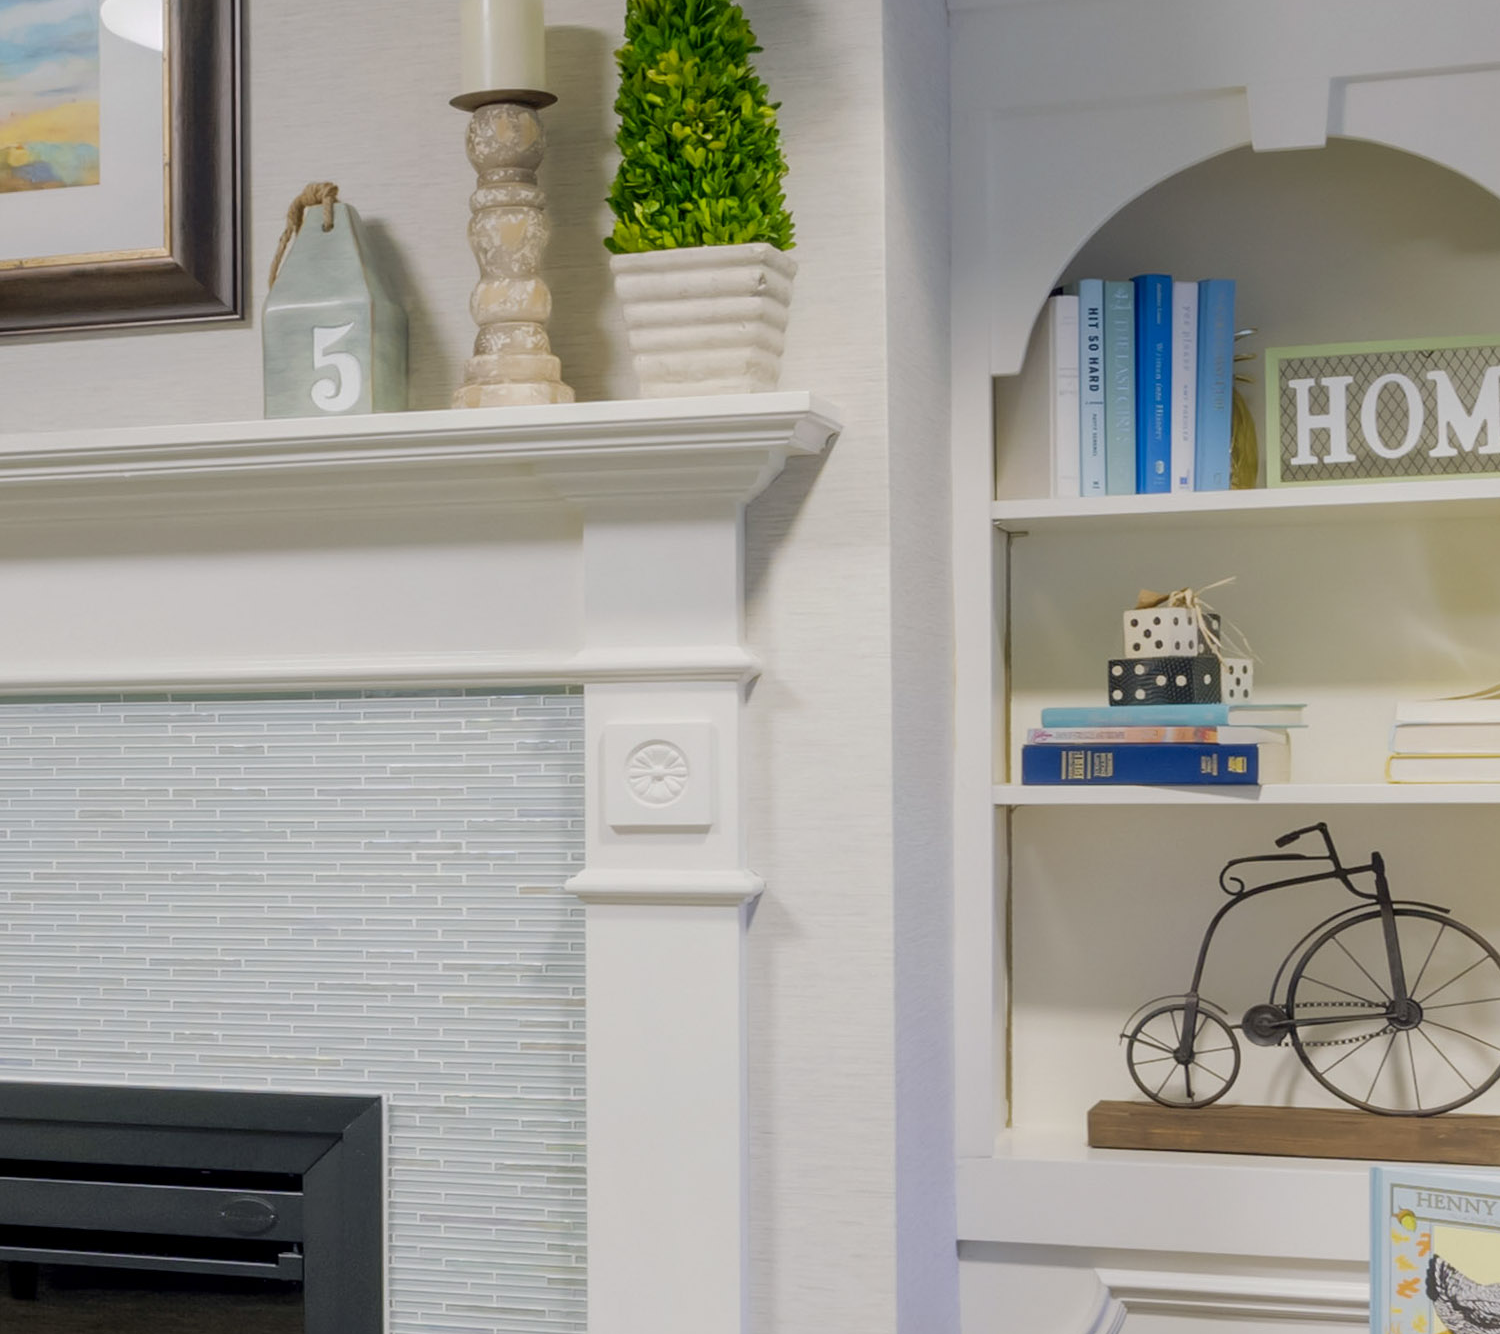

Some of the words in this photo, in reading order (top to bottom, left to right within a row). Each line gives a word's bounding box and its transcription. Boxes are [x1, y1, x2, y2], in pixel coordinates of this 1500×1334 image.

[1088, 308, 1098, 329] HIT
[1088, 336, 1099, 351] SO
[311, 322, 361, 412] 5
[1089, 357, 1099, 392] HARD
[1416, 1191, 1498, 1216] HENNY
